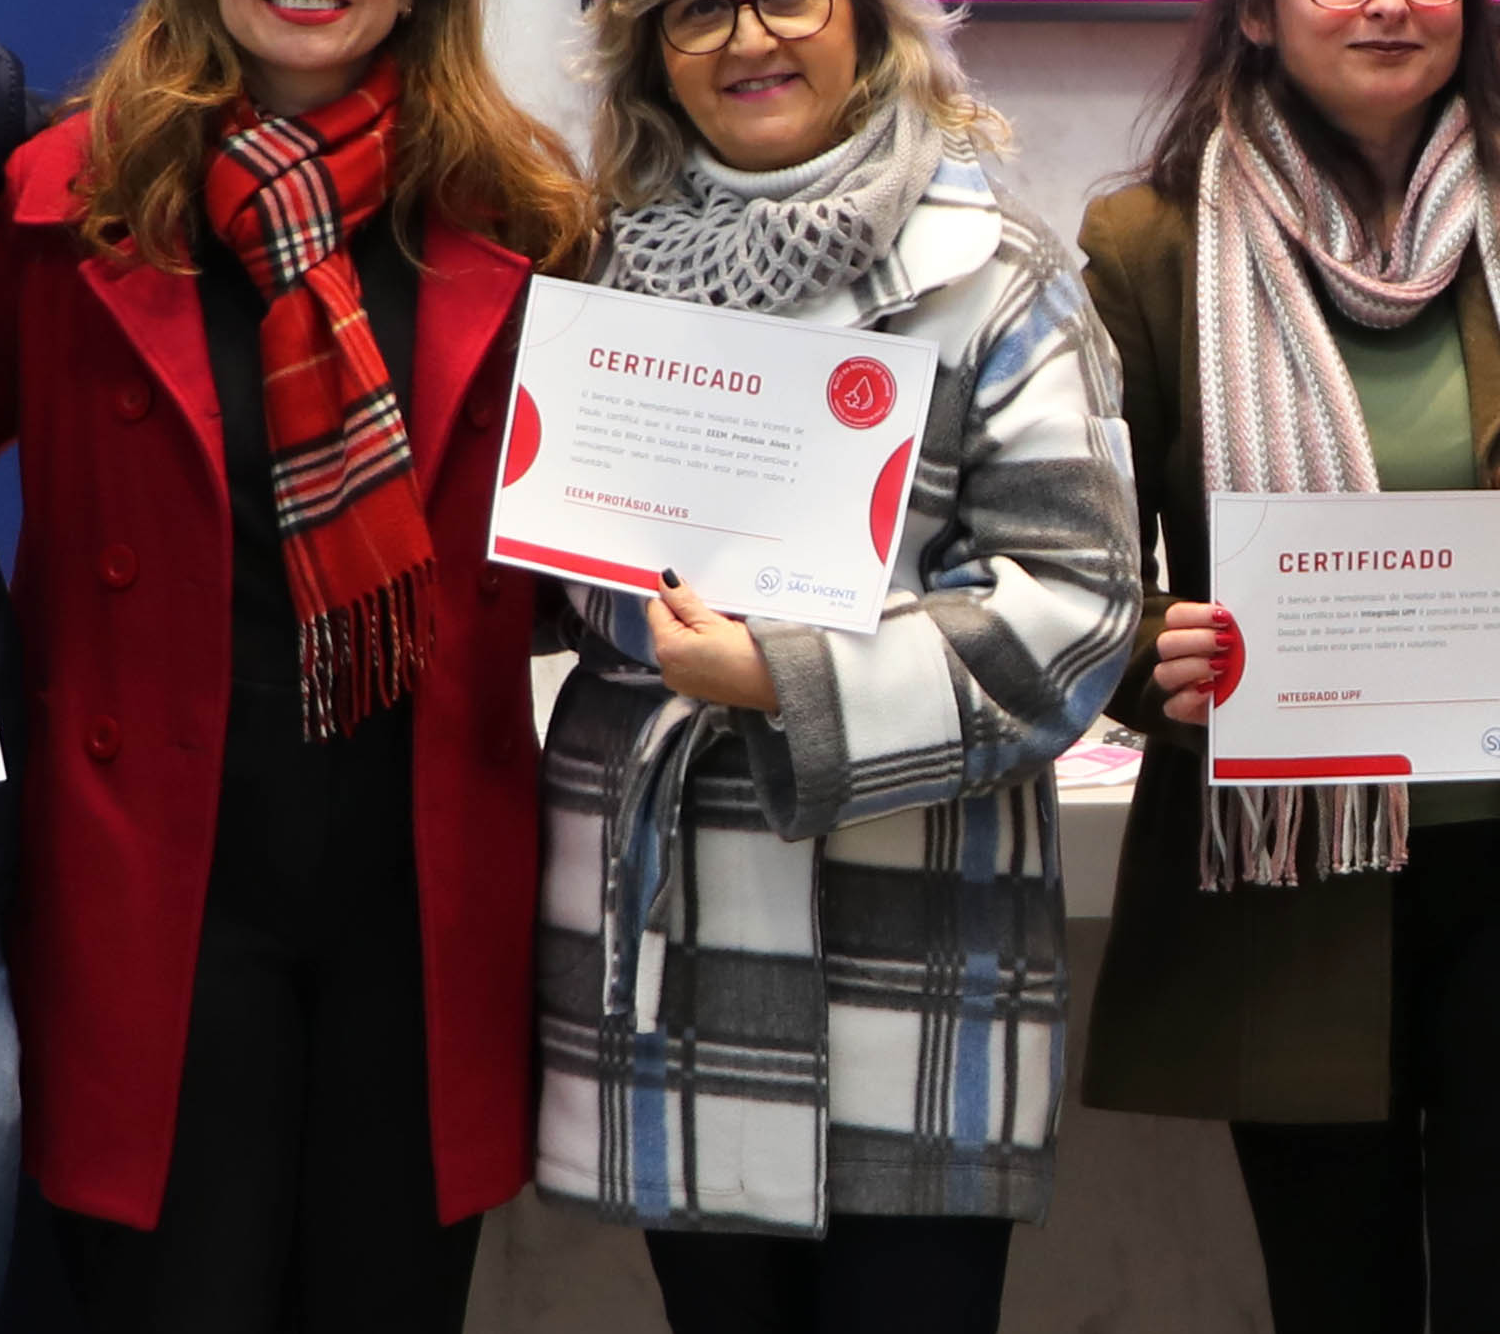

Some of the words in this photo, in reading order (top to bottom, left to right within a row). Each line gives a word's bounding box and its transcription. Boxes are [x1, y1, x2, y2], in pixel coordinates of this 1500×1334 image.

[589, 347, 763, 396] CERTIFICADO
[565, 485, 594, 500] EEEM
[596, 492, 651, 512] PROTÁSIO
[653, 504, 690, 518] ALVES
[1278, 549, 1453, 573] CERTIFICADO
[1277, 691, 1338, 703] INTEGRADO
[1341, 689, 1363, 700] UPF
